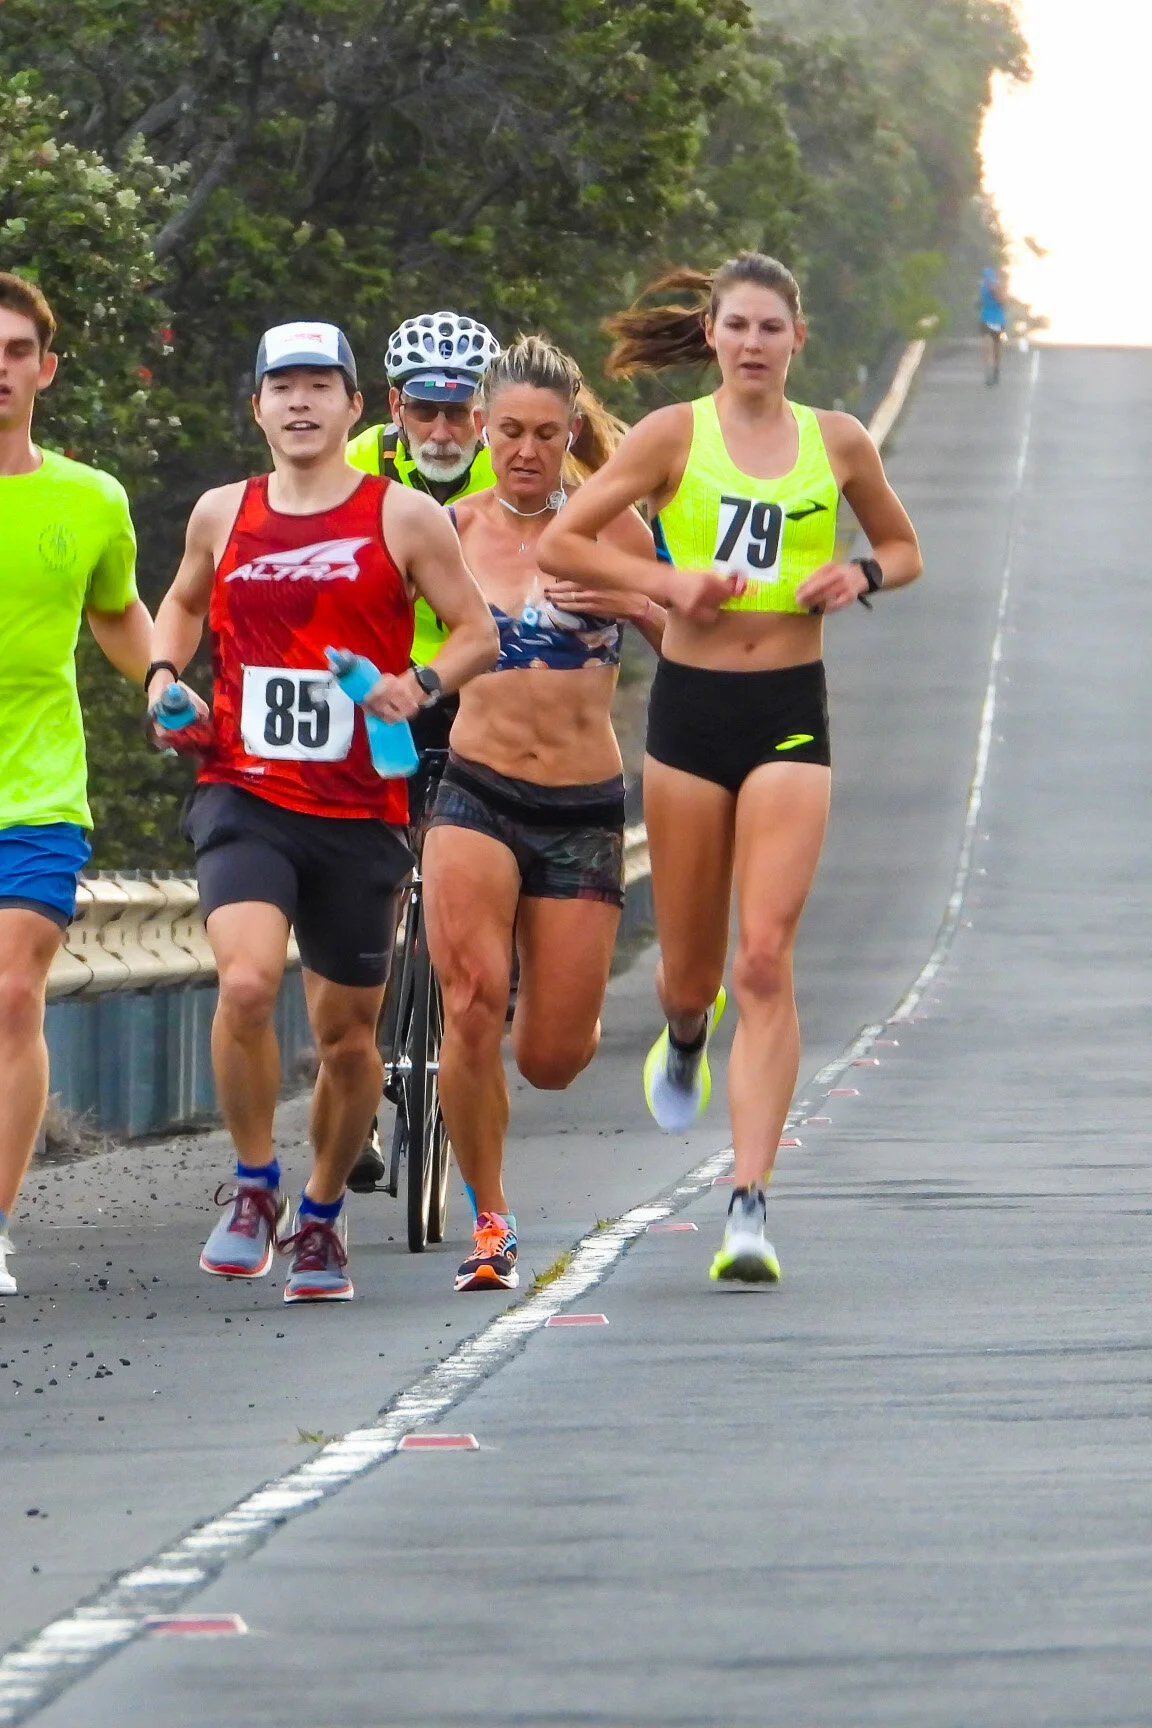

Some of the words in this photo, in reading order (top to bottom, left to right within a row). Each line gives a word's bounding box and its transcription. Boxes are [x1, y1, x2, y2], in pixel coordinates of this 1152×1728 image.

[714, 494, 783, 569] 79
[224, 563, 360, 583] ALTRA
[263, 677, 331, 748] 85
